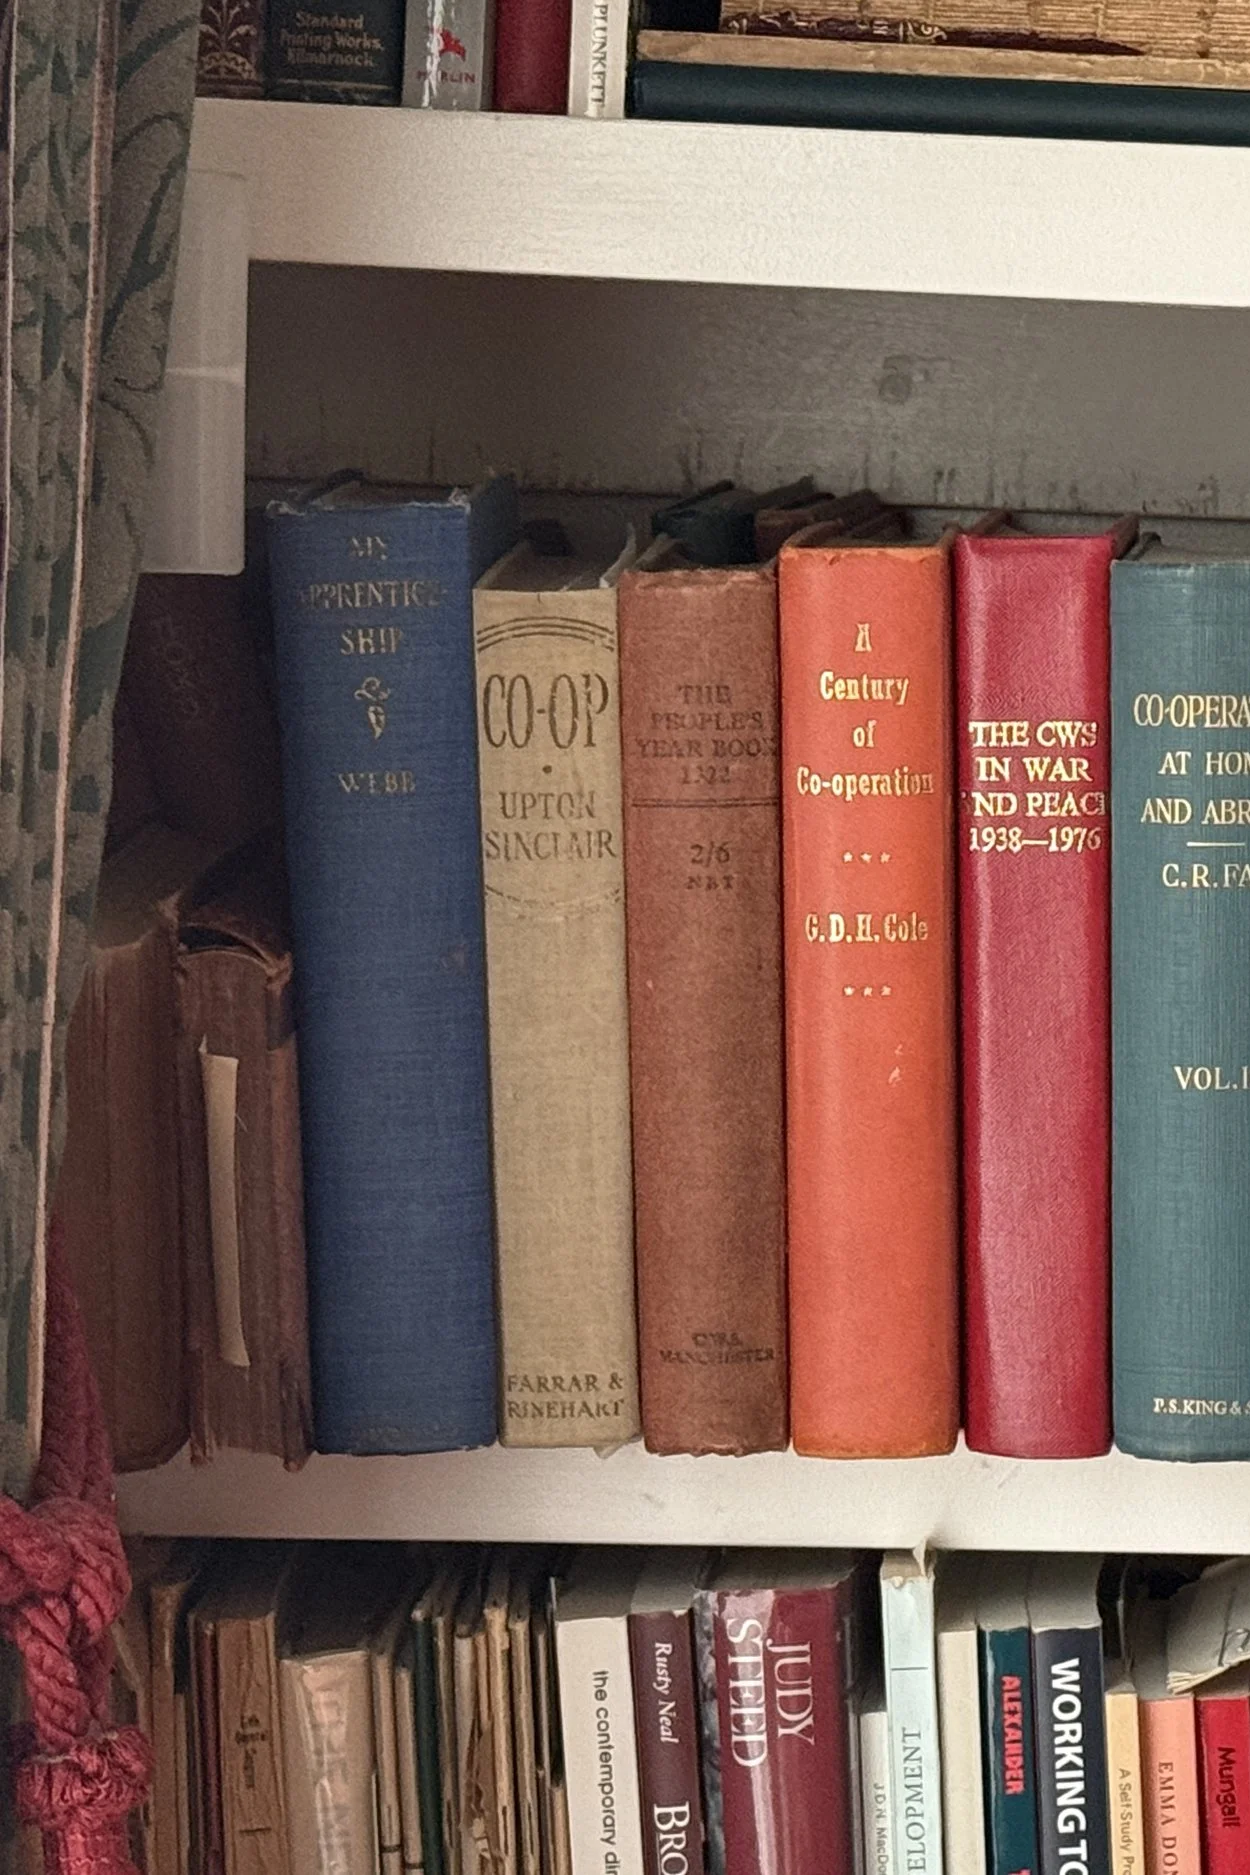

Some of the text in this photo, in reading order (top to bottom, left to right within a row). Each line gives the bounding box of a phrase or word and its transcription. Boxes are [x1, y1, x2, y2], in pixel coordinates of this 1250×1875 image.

[295, 11, 364, 30] Standard
[340, 627, 403, 655] SHIP
[855, 623, 873, 653] A
[678, 685, 732, 704] THE
[819, 670, 910, 705] Century
[483, 673, 609, 749] CO-OP
[636, 738, 703, 758] YEAR
[853, 720, 878, 748] of
[968, 720, 1098, 748] THE CWS
[975, 756, 1094, 783] IN WAR
[1158, 750, 1192, 775] AT
[796, 766, 934, 801] Co-operation
[499, 790, 596, 820] UPTON
[1140, 798, 1192, 825] AND
[485, 829, 617, 862] SINCLAIR
[884, 912, 929, 942] Cole
[506, 1372, 624, 1393] FARRAR &
[507, 1399, 625, 1419] RINEHART
[592, 1670, 609, 1702] the
[652, 1642, 679, 1744] Rusty Neal
[726, 1618, 768, 1767] STEED
[767, 1638, 815, 1747] JUDY
[1050, 1657, 1087, 1834] WORKING
[595, 1707, 617, 1846] contemporary
[1118, 1767, 1131, 1779] A
[1216, 1747, 1241, 1828] Mungall
[874, 1794, 887, 1805] D
[1158, 1762, 1176, 1826] EMMA
[875, 1808, 887, 1819] N
[1118, 1782, 1134, 1852] Self-Study
